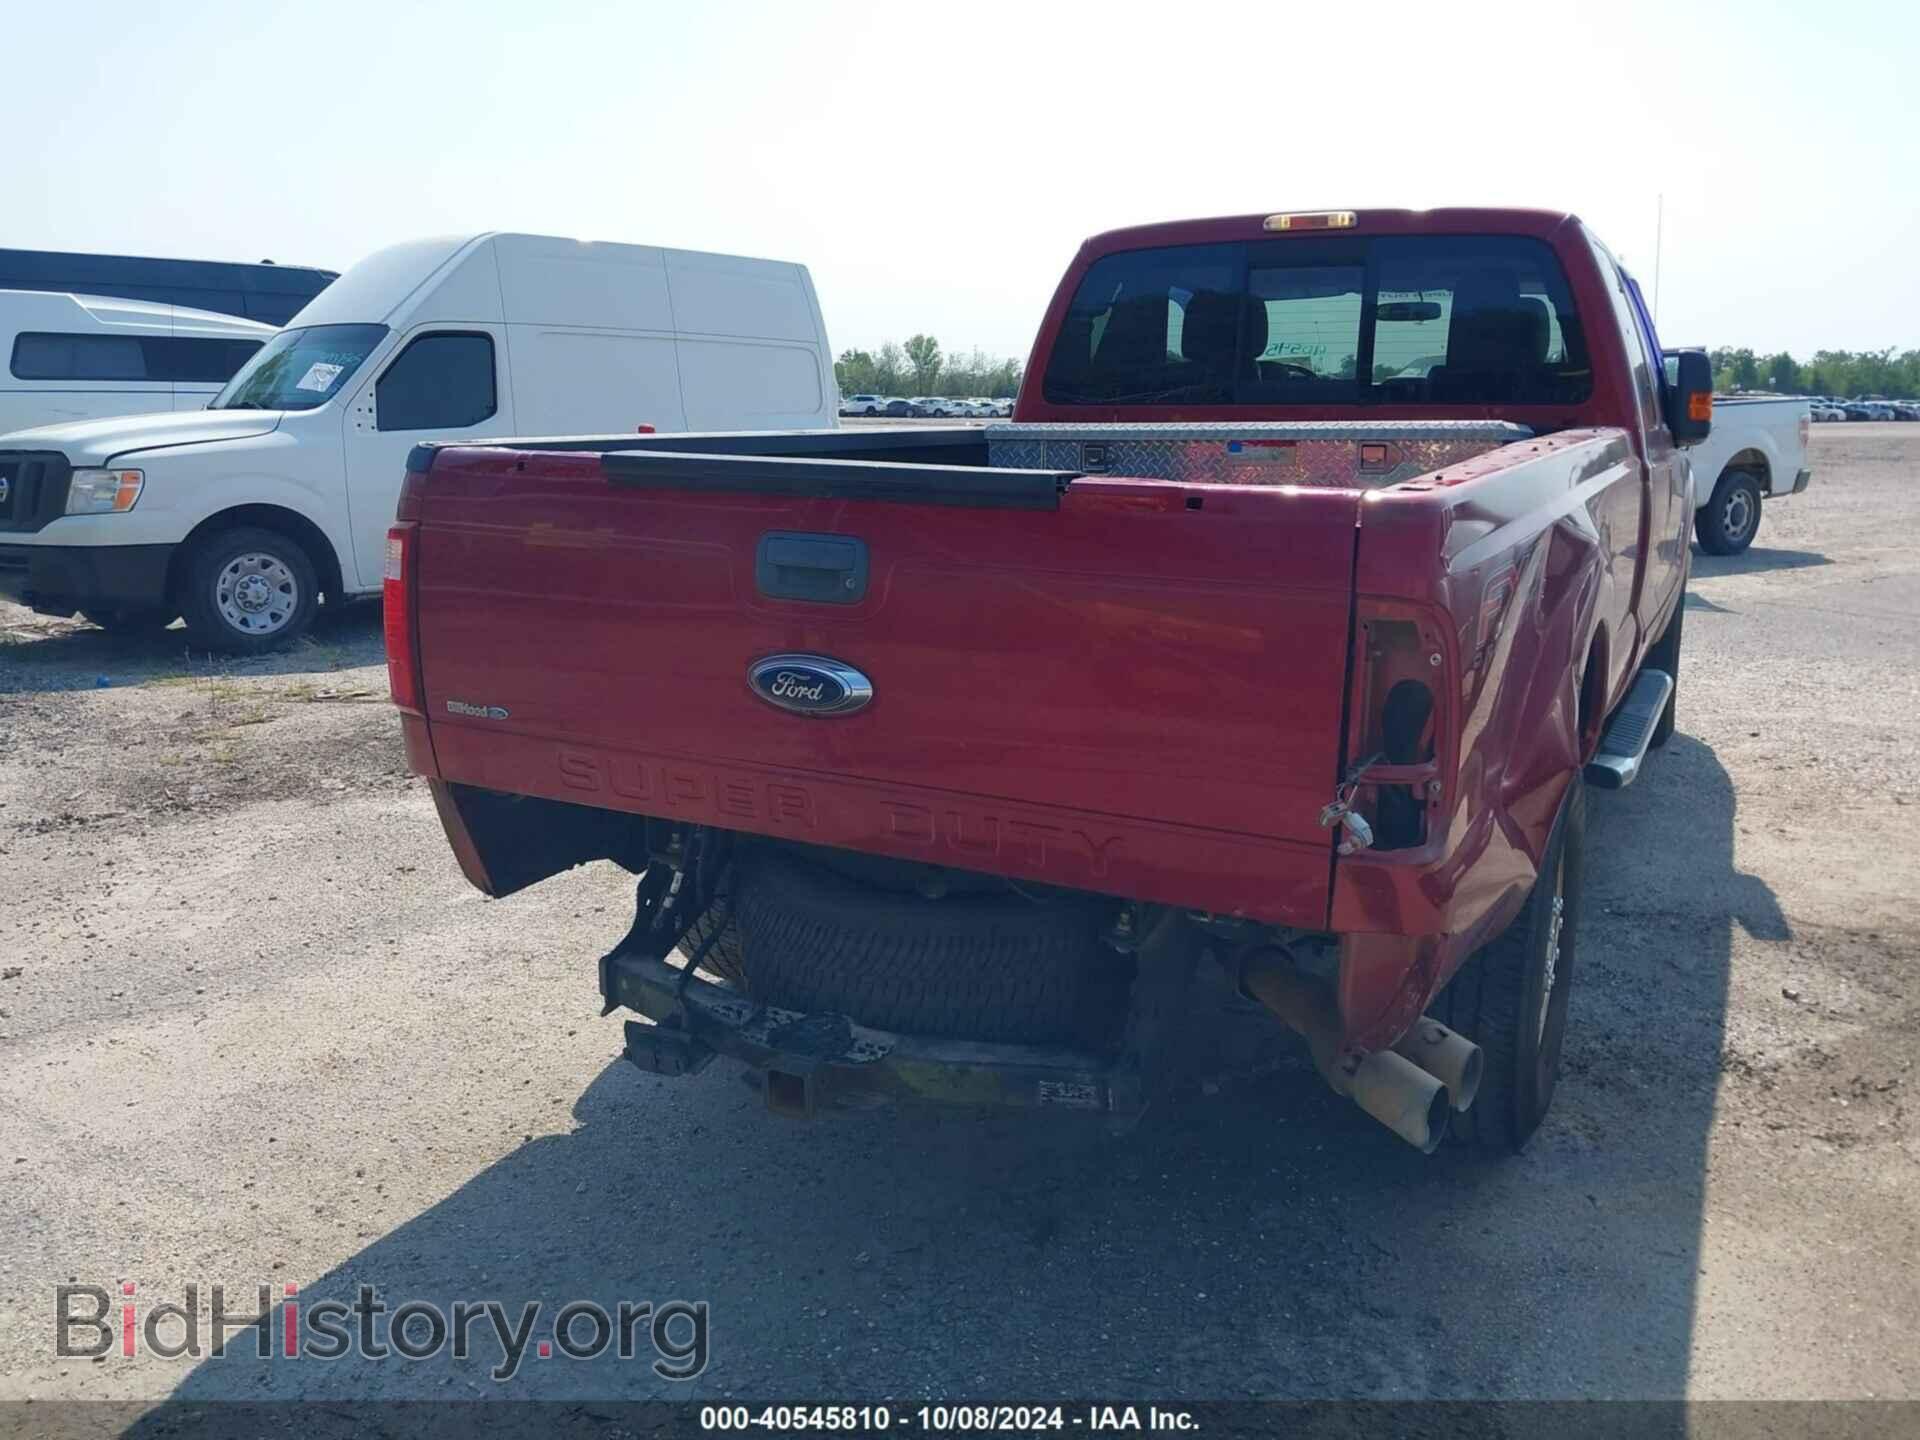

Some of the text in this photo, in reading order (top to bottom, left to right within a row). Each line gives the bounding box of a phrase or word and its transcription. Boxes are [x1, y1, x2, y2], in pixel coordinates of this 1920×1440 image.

[771, 671, 824, 700] Ford
[557, 750, 1125, 876] SUPER DUTY
